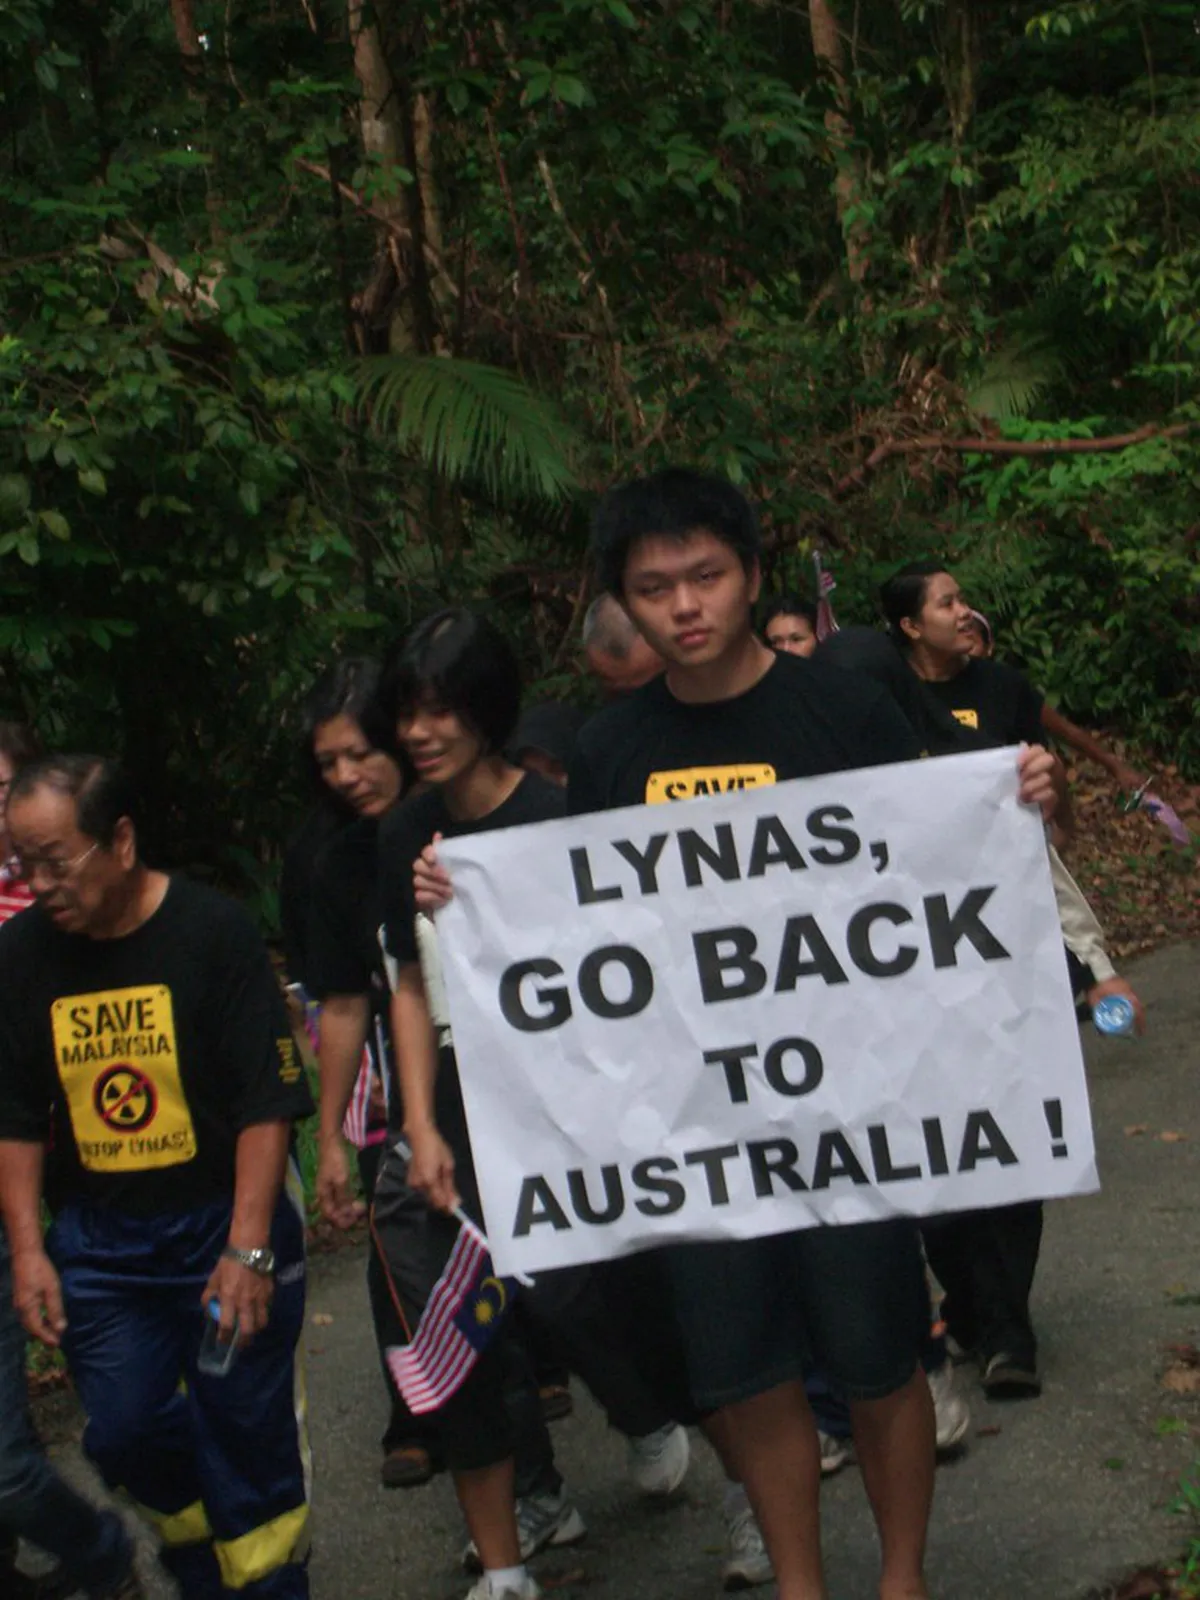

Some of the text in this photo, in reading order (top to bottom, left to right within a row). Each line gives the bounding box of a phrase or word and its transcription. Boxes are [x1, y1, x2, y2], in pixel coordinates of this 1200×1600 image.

[569, 804, 890, 905] LYNAS,
[499, 885, 1012, 1033] GO BACK
[61, 1033, 172, 1066] MALAYSIA
[69, 997, 155, 1040] SAVE
[702, 1036, 824, 1105] TO
[512, 1098, 1069, 1238] AUSTRALIA !
